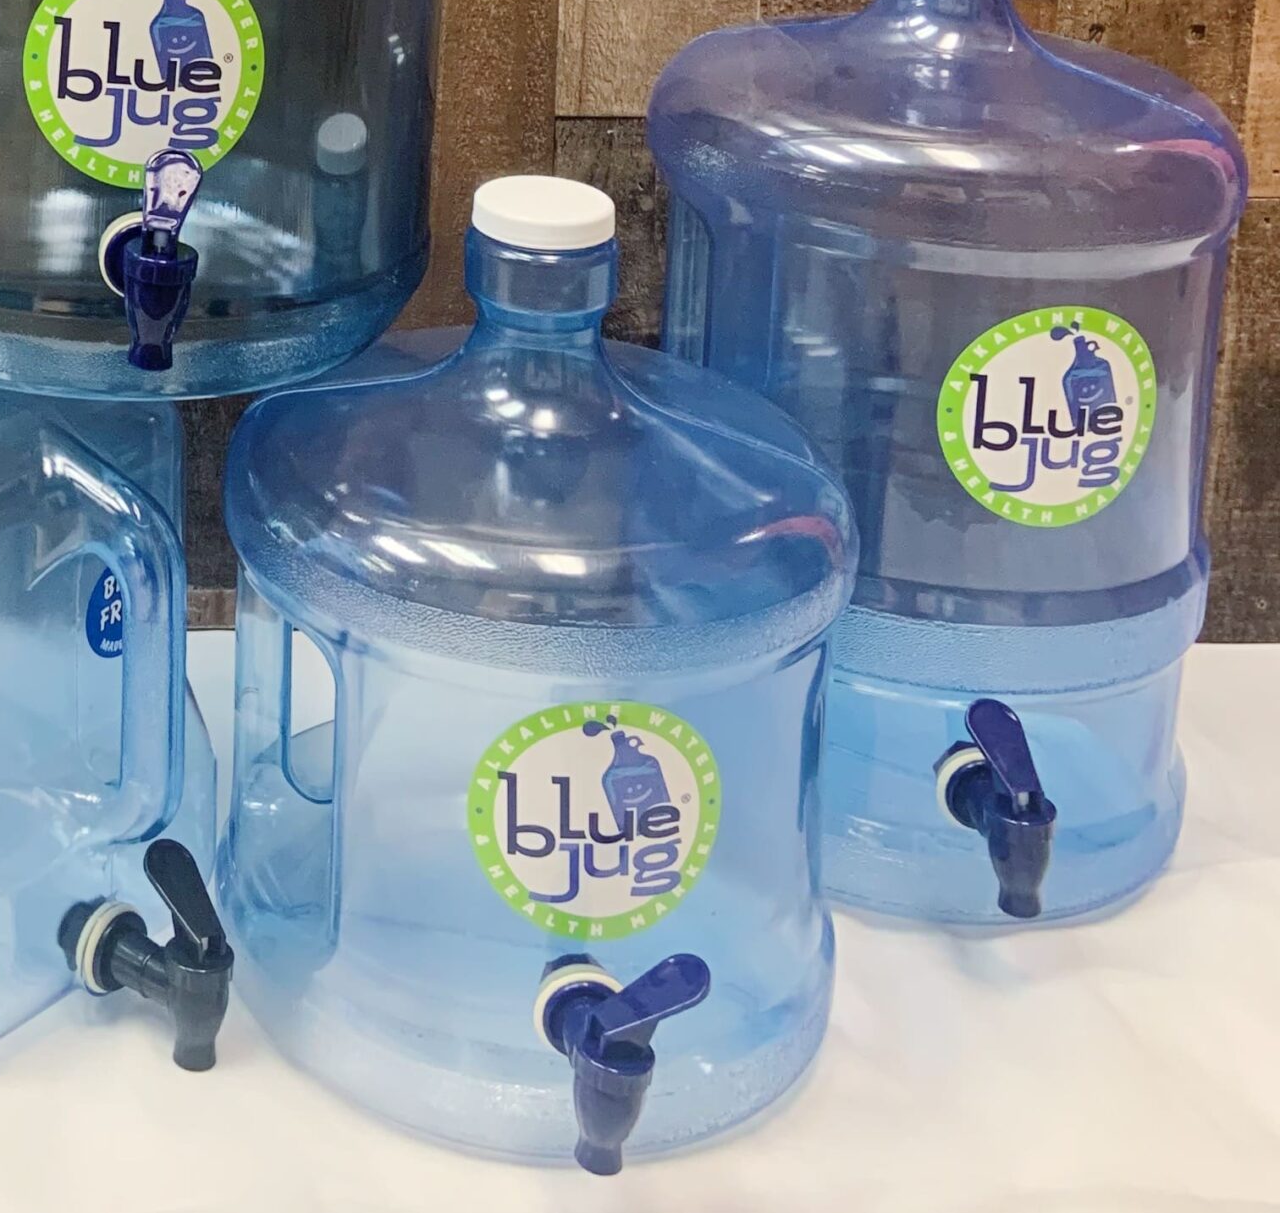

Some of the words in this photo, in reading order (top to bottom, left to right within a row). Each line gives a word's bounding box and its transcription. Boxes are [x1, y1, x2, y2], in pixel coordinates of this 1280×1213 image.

[39, 110, 140, 182] HEALTH
[949, 312, 1084, 392] ALKALINE
[1105, 321, 1153, 389] WATER
[953, 457, 1053, 523] HEALTH
[1075, 425, 1149, 516] MARKET
[104, 576, 120, 599] B
[476, 705, 620, 791] ALKALINE
[649, 711, 715, 785] WATER
[488, 864, 602, 936] HEALTH
[630, 823, 715, 929] MARKET
